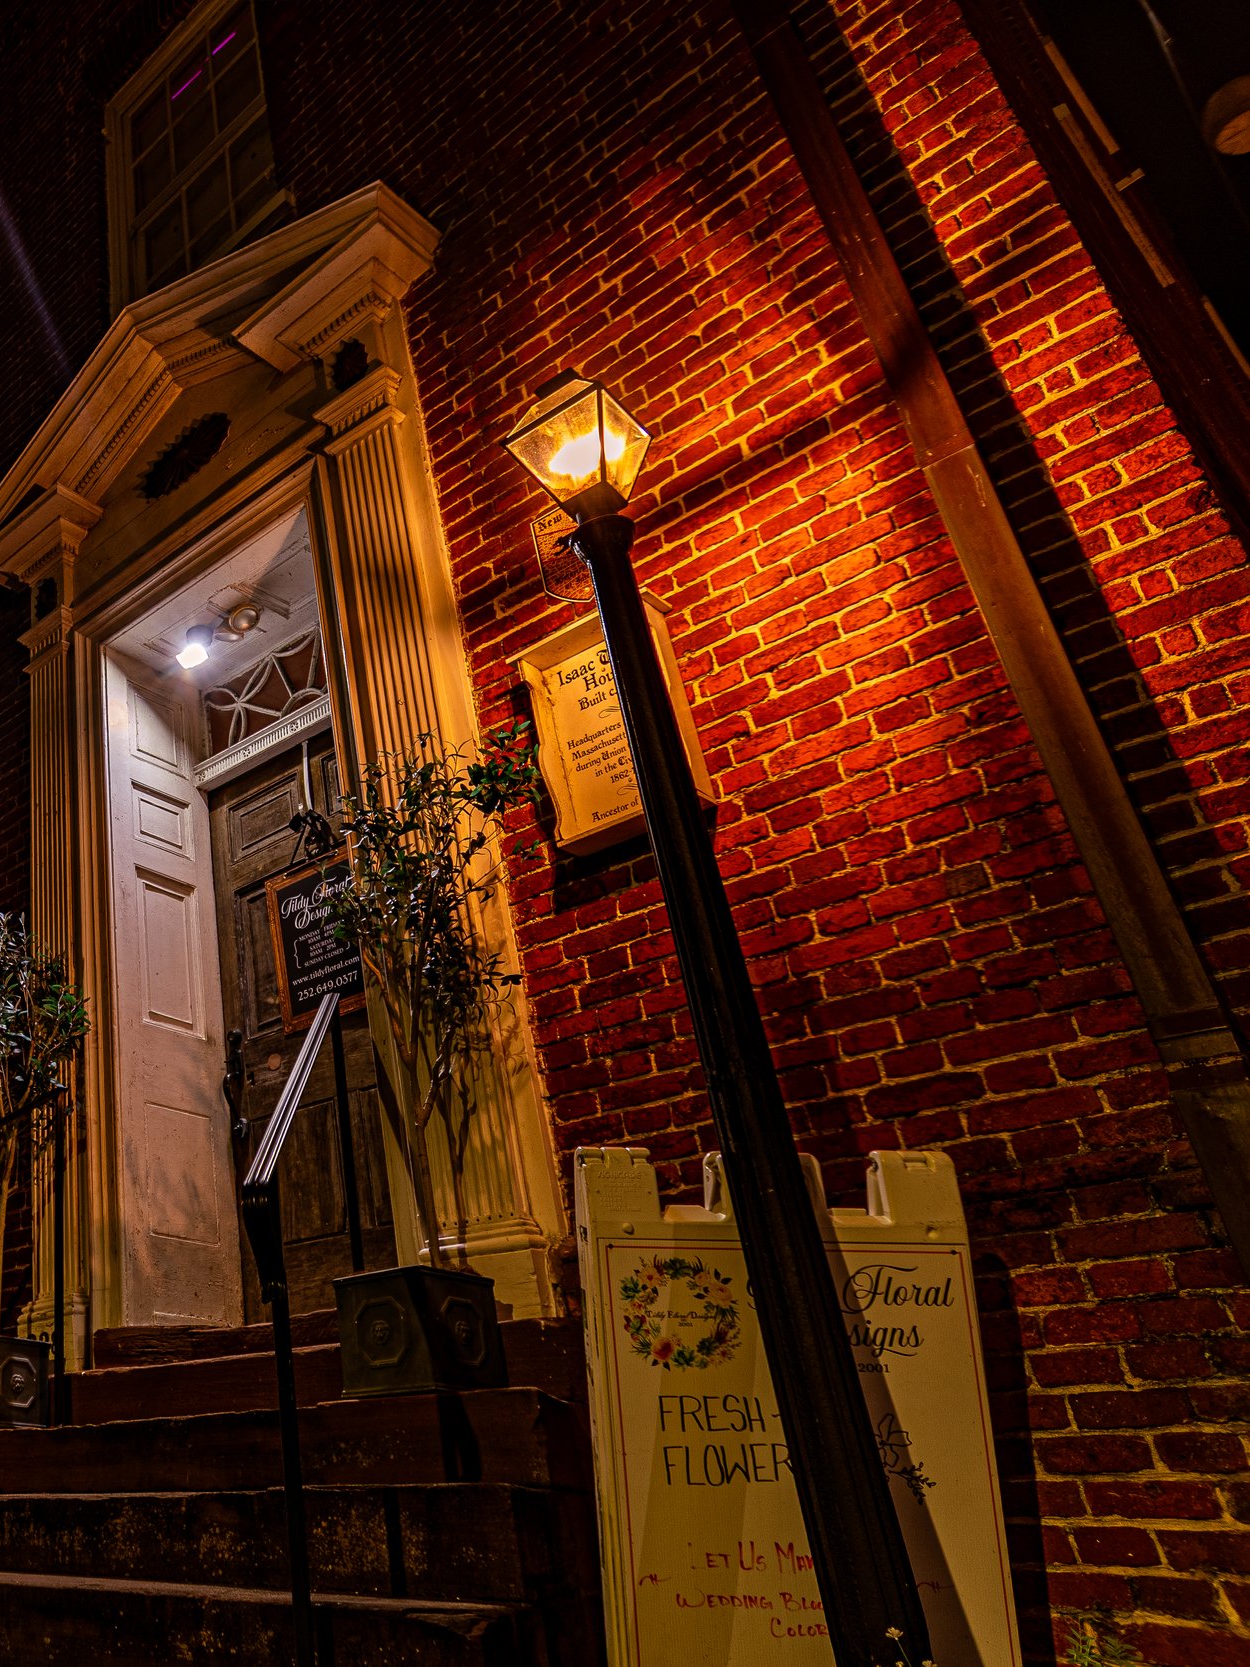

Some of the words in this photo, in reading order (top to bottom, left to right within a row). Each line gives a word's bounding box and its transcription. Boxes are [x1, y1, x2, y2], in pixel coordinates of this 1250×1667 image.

[537, 514, 563, 533] New
[557, 661, 595, 687] Isaac
[583, 672, 614, 692] Hou
[578, 691, 607, 711] Built
[567, 722, 621, 750] Headquarters
[572, 731, 627, 761] Massachusett
[575, 757, 601, 772] during
[601, 746, 627, 761] Union
[595, 768, 603, 777] in
[604, 762, 617, 773] the
[617, 755, 632, 766] Civ
[592, 803, 629, 823] Ancestor
[631, 795, 639, 808] of
[281, 893, 310, 919] Tildy
[299, 929, 320, 941] MONDAY
[310, 938, 335, 951] SATURDAY
[292, 956, 360, 986] www.tildyfloral.com
[298, 970, 358, 1001] 252.649.0377
[839, 1264, 954, 1314] Floral
[849, 1320, 924, 1357] signs
[858, 1363, 890, 1374] 2001
[663, 1443, 793, 1487] FLOWER
